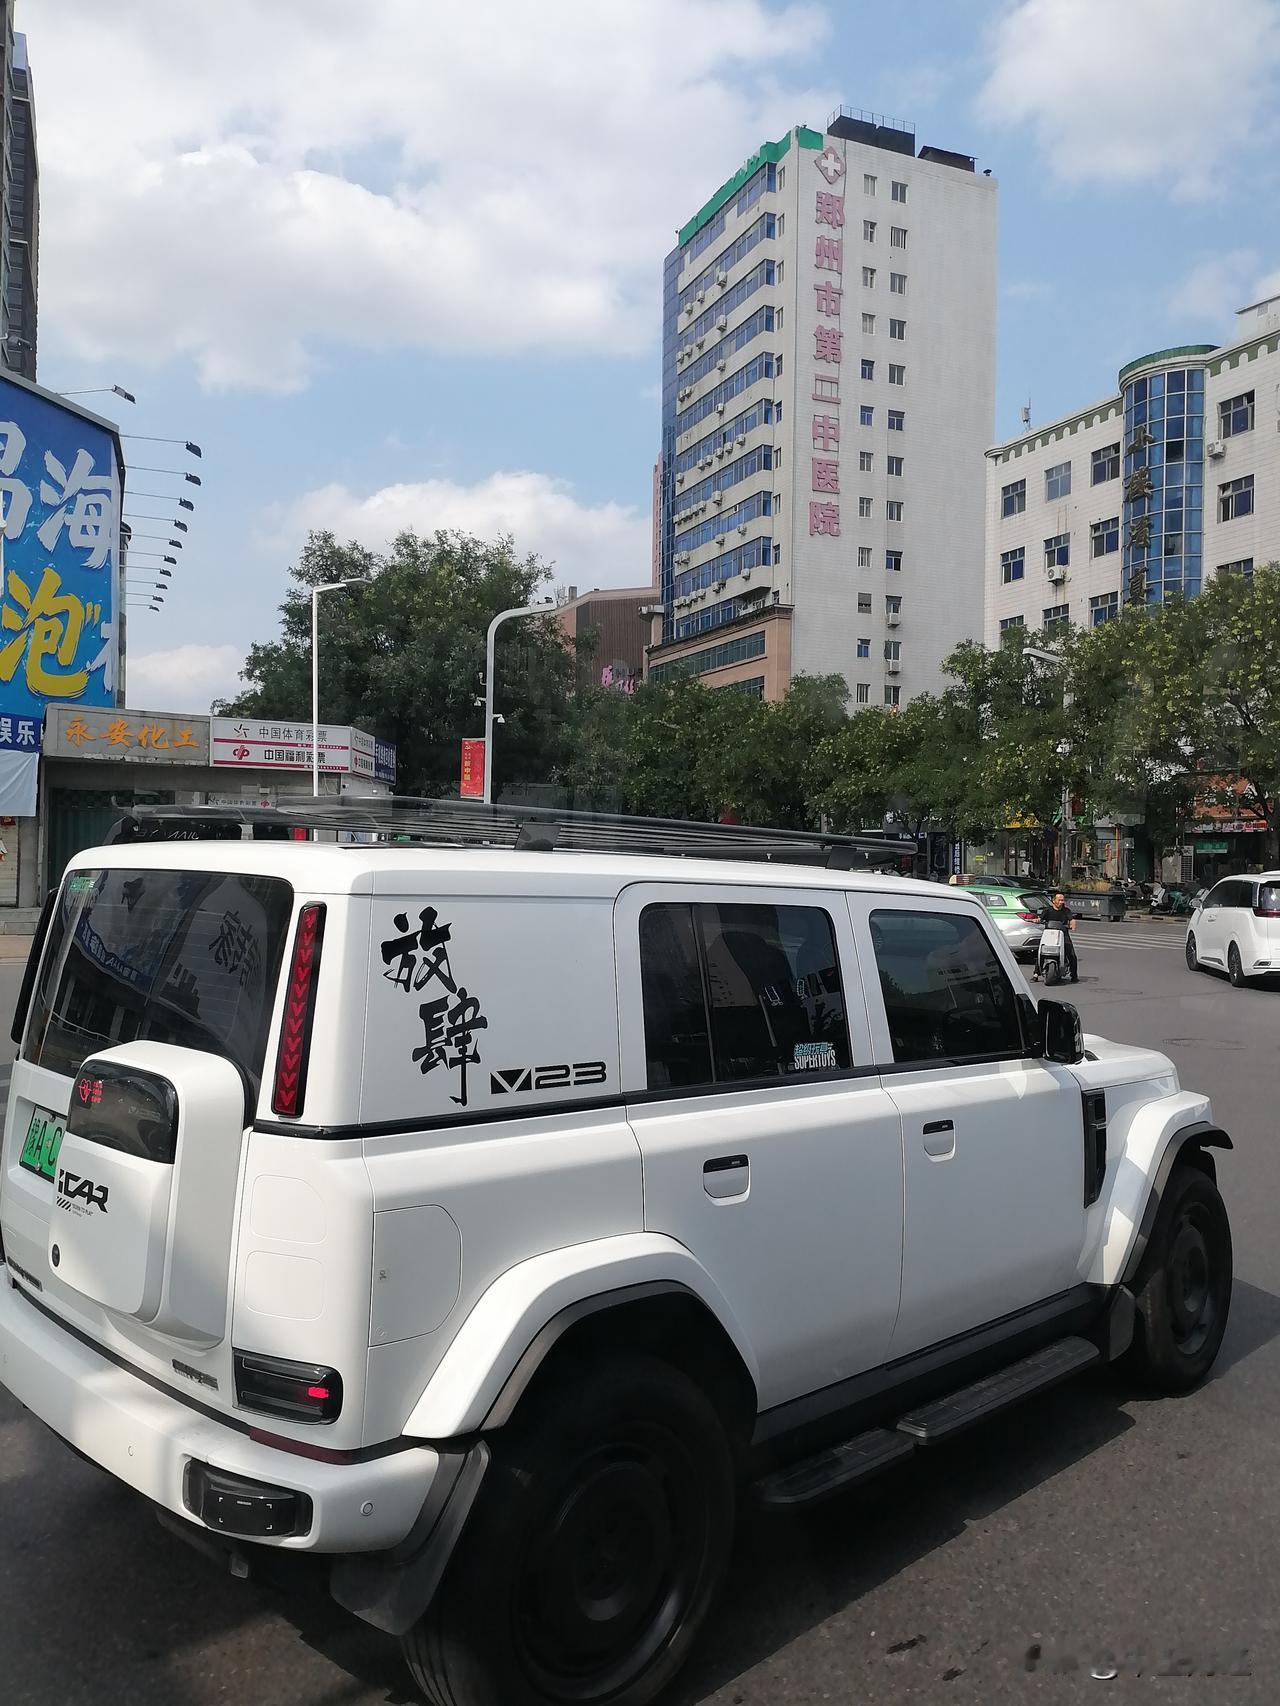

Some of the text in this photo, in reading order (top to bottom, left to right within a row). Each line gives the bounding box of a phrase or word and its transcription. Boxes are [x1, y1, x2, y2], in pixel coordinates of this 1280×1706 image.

[809, 190, 846, 537] 郑州市第二中医院
[65, 715, 200, 749] 永安化工
[259, 726, 328, 742] 中国体育彩票
[264, 749, 326, 763] 中国福利彩票
[794, 1049, 836, 1070] SUPERTOYS
